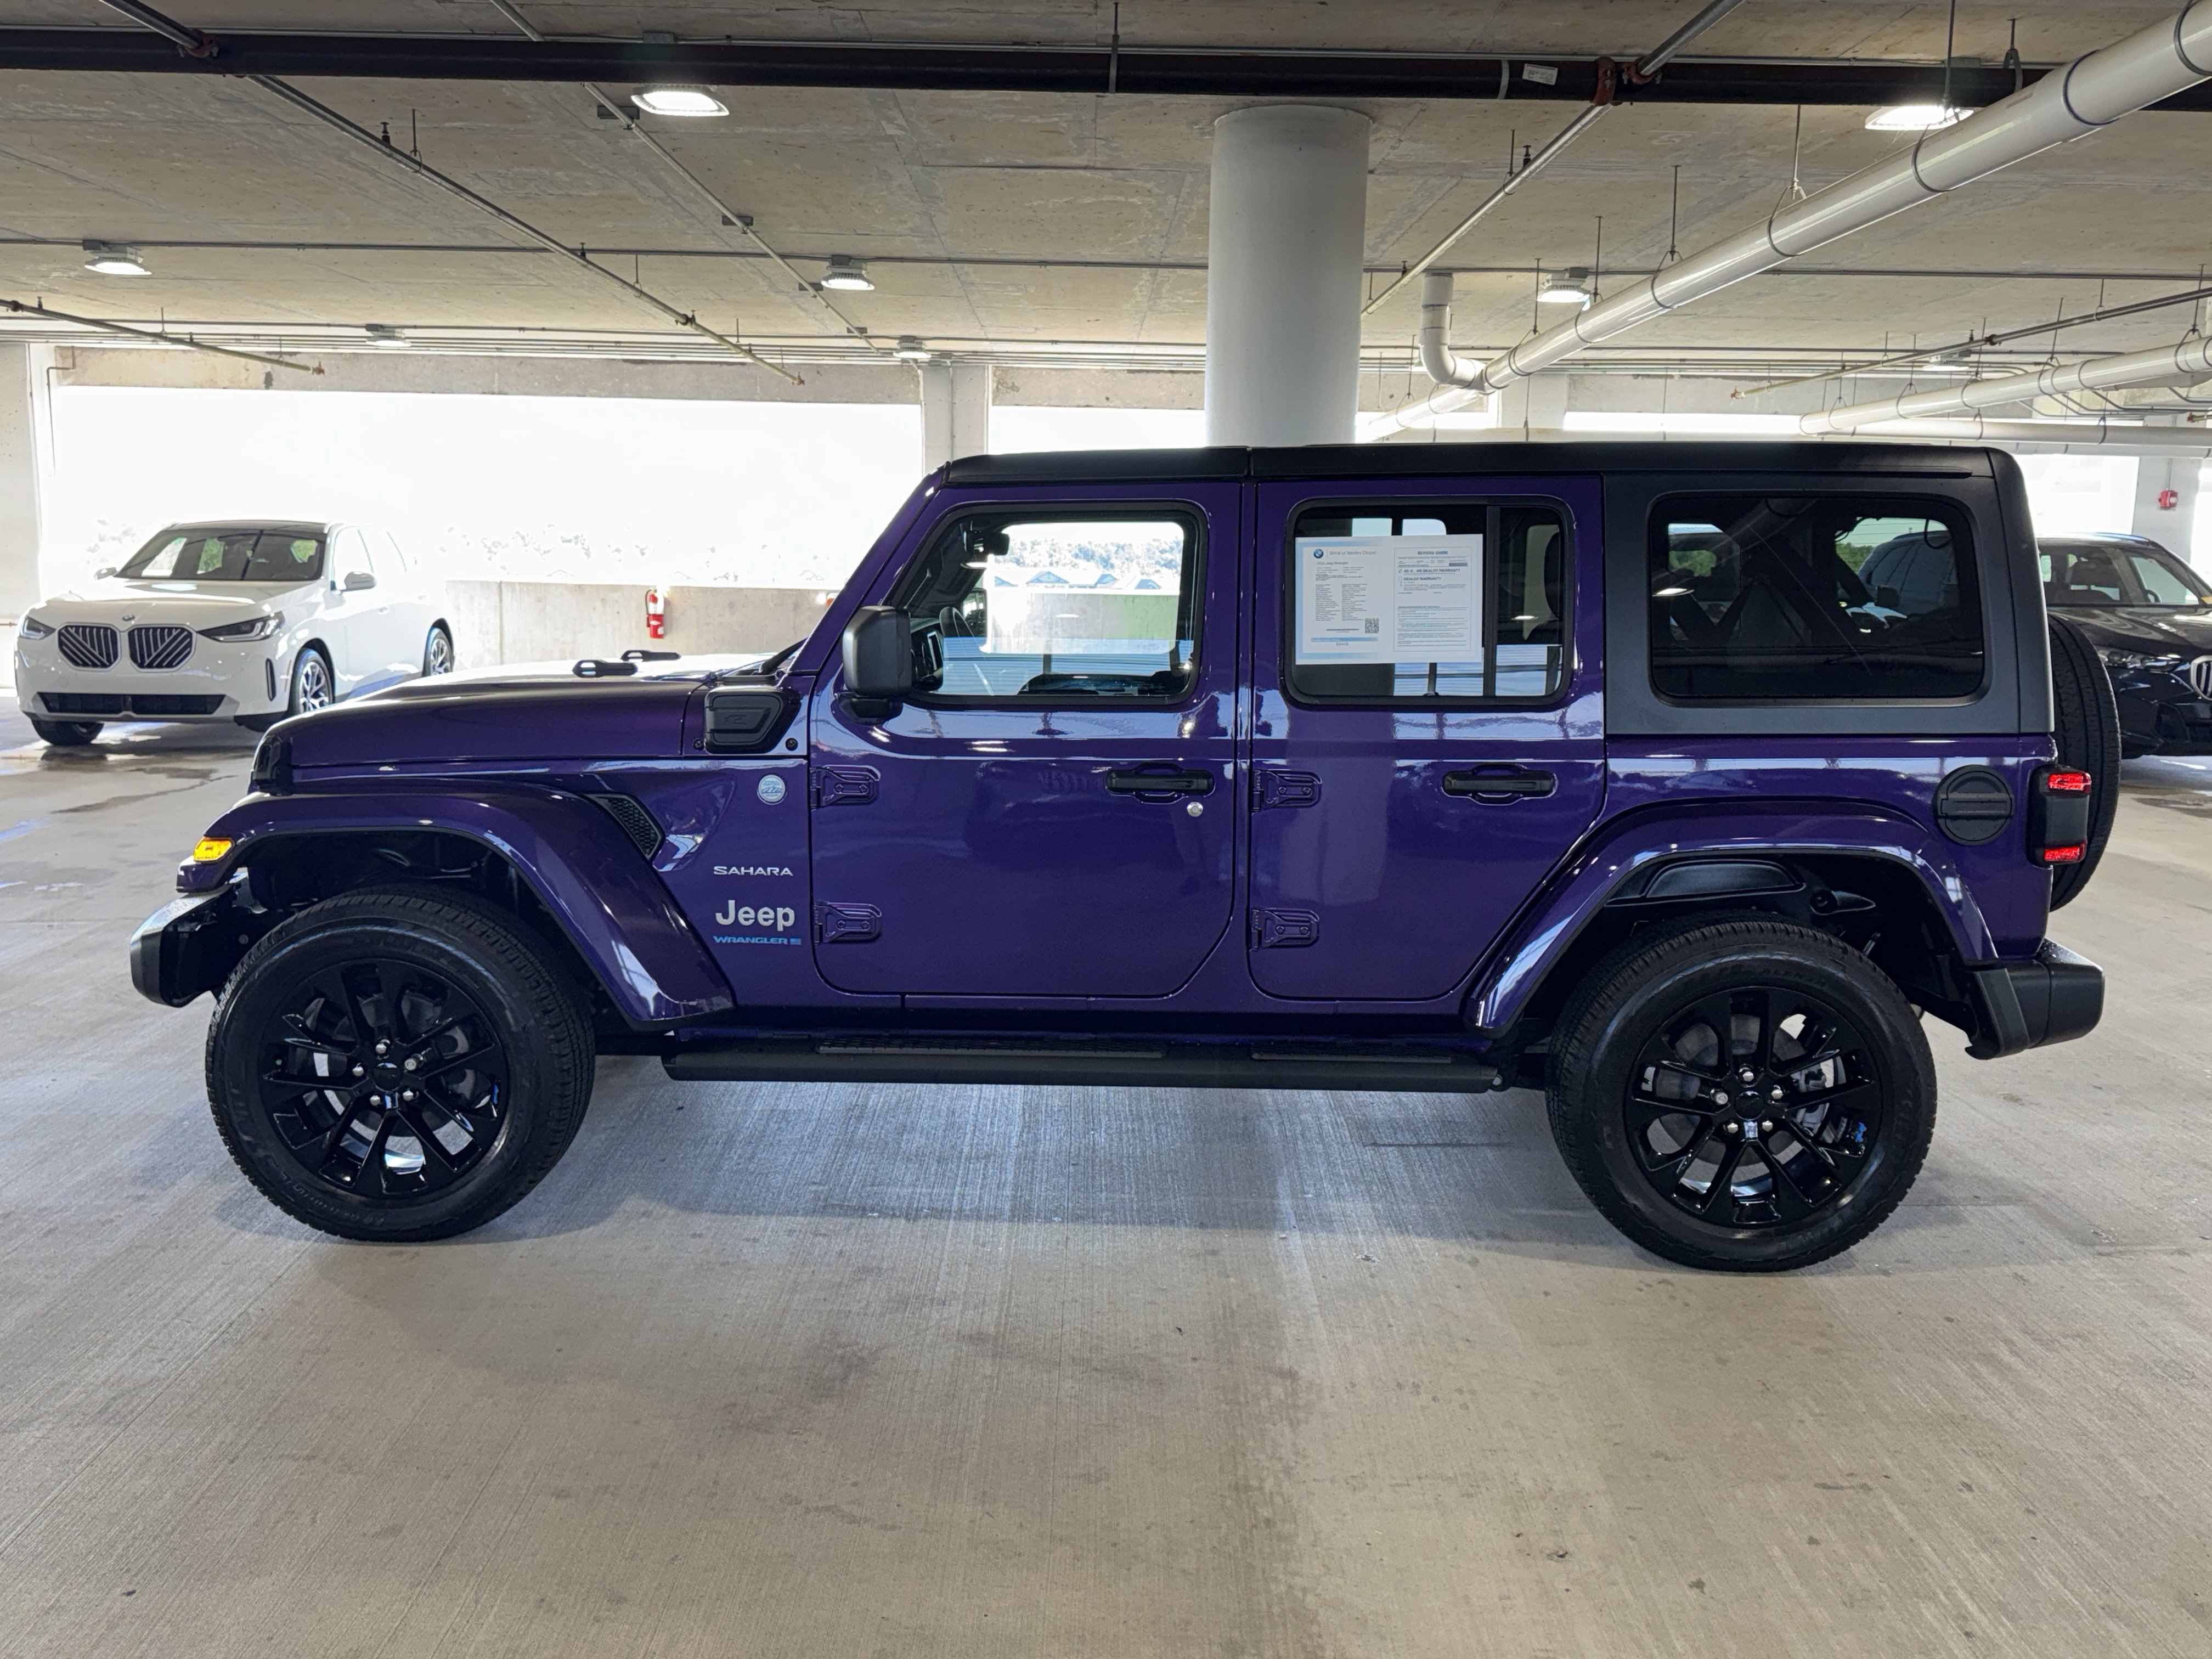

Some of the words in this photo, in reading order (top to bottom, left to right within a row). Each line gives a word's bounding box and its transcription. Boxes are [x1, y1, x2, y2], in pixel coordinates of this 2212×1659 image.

[713, 866, 793, 876] SAHARA
[715, 900, 795, 931] Jeep
[713, 936, 788, 944] WRANGLER
